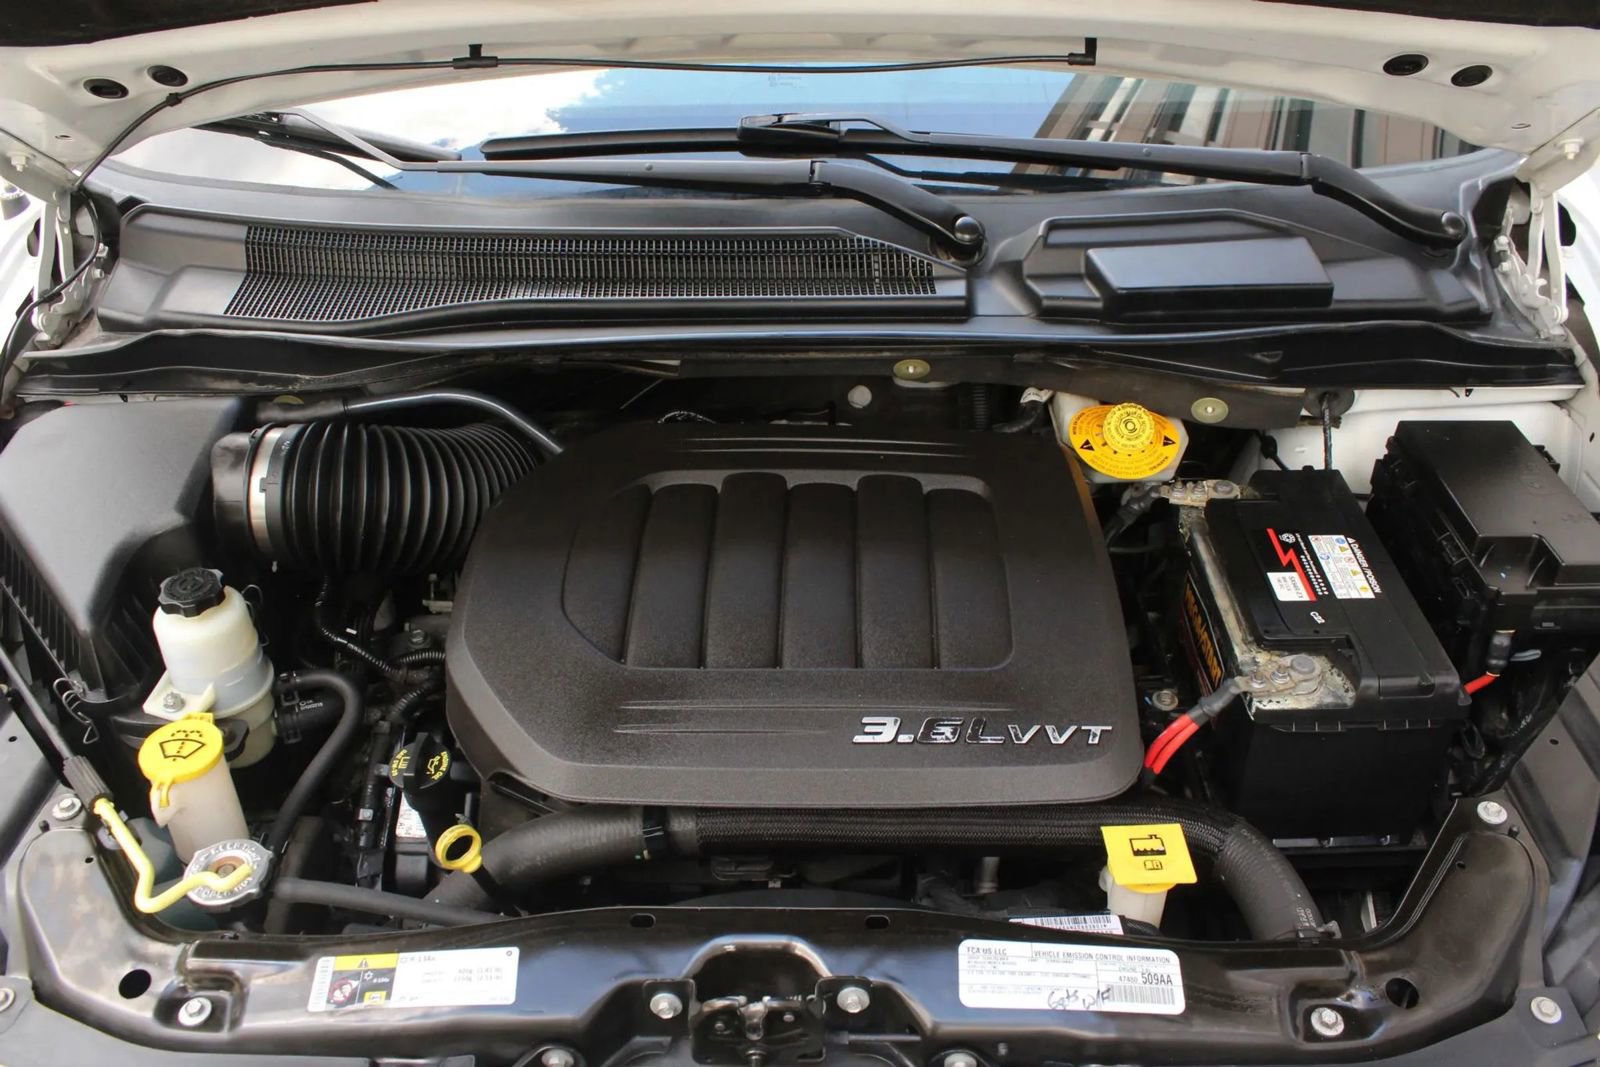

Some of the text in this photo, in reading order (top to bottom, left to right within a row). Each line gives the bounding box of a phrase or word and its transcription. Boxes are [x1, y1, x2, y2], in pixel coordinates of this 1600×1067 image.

[1350, 543, 1369, 568] DANGER
[967, 946, 1007, 956] FCA US LLC
[1033, 950, 1171, 964] VEHICLE EMISSION CONTROL INFORMATION
[1141, 972, 1173, 986] 509AA
